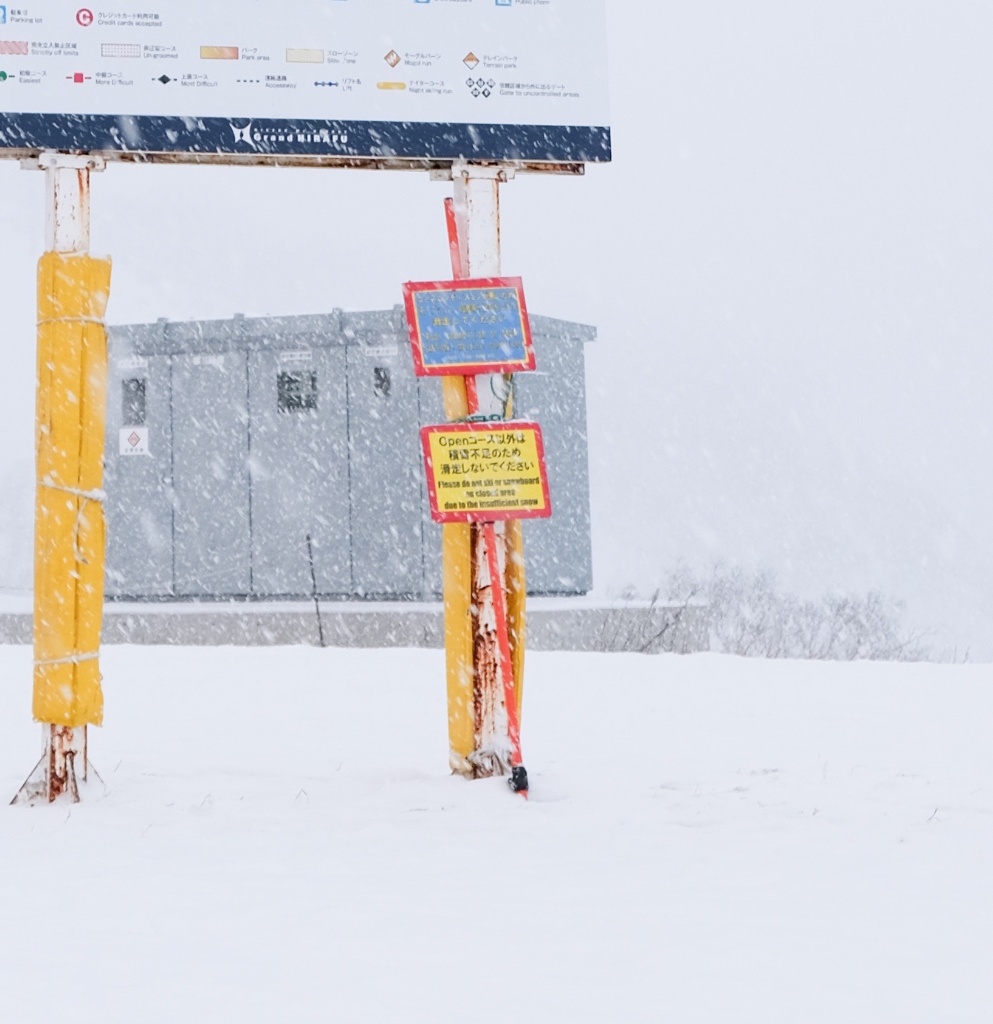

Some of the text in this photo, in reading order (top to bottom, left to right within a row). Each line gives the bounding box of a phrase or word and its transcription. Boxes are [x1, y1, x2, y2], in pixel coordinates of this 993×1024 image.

[254, 133, 348, 143] Grand HIRAFU
[439, 432, 525, 447] Openコース以外は
[449, 448, 521, 460] 積雪不足のため
[441, 462, 534, 475] 滑走しないでください
[503, 477, 539, 485] snowboard
[479, 499, 518, 507] insufficient
